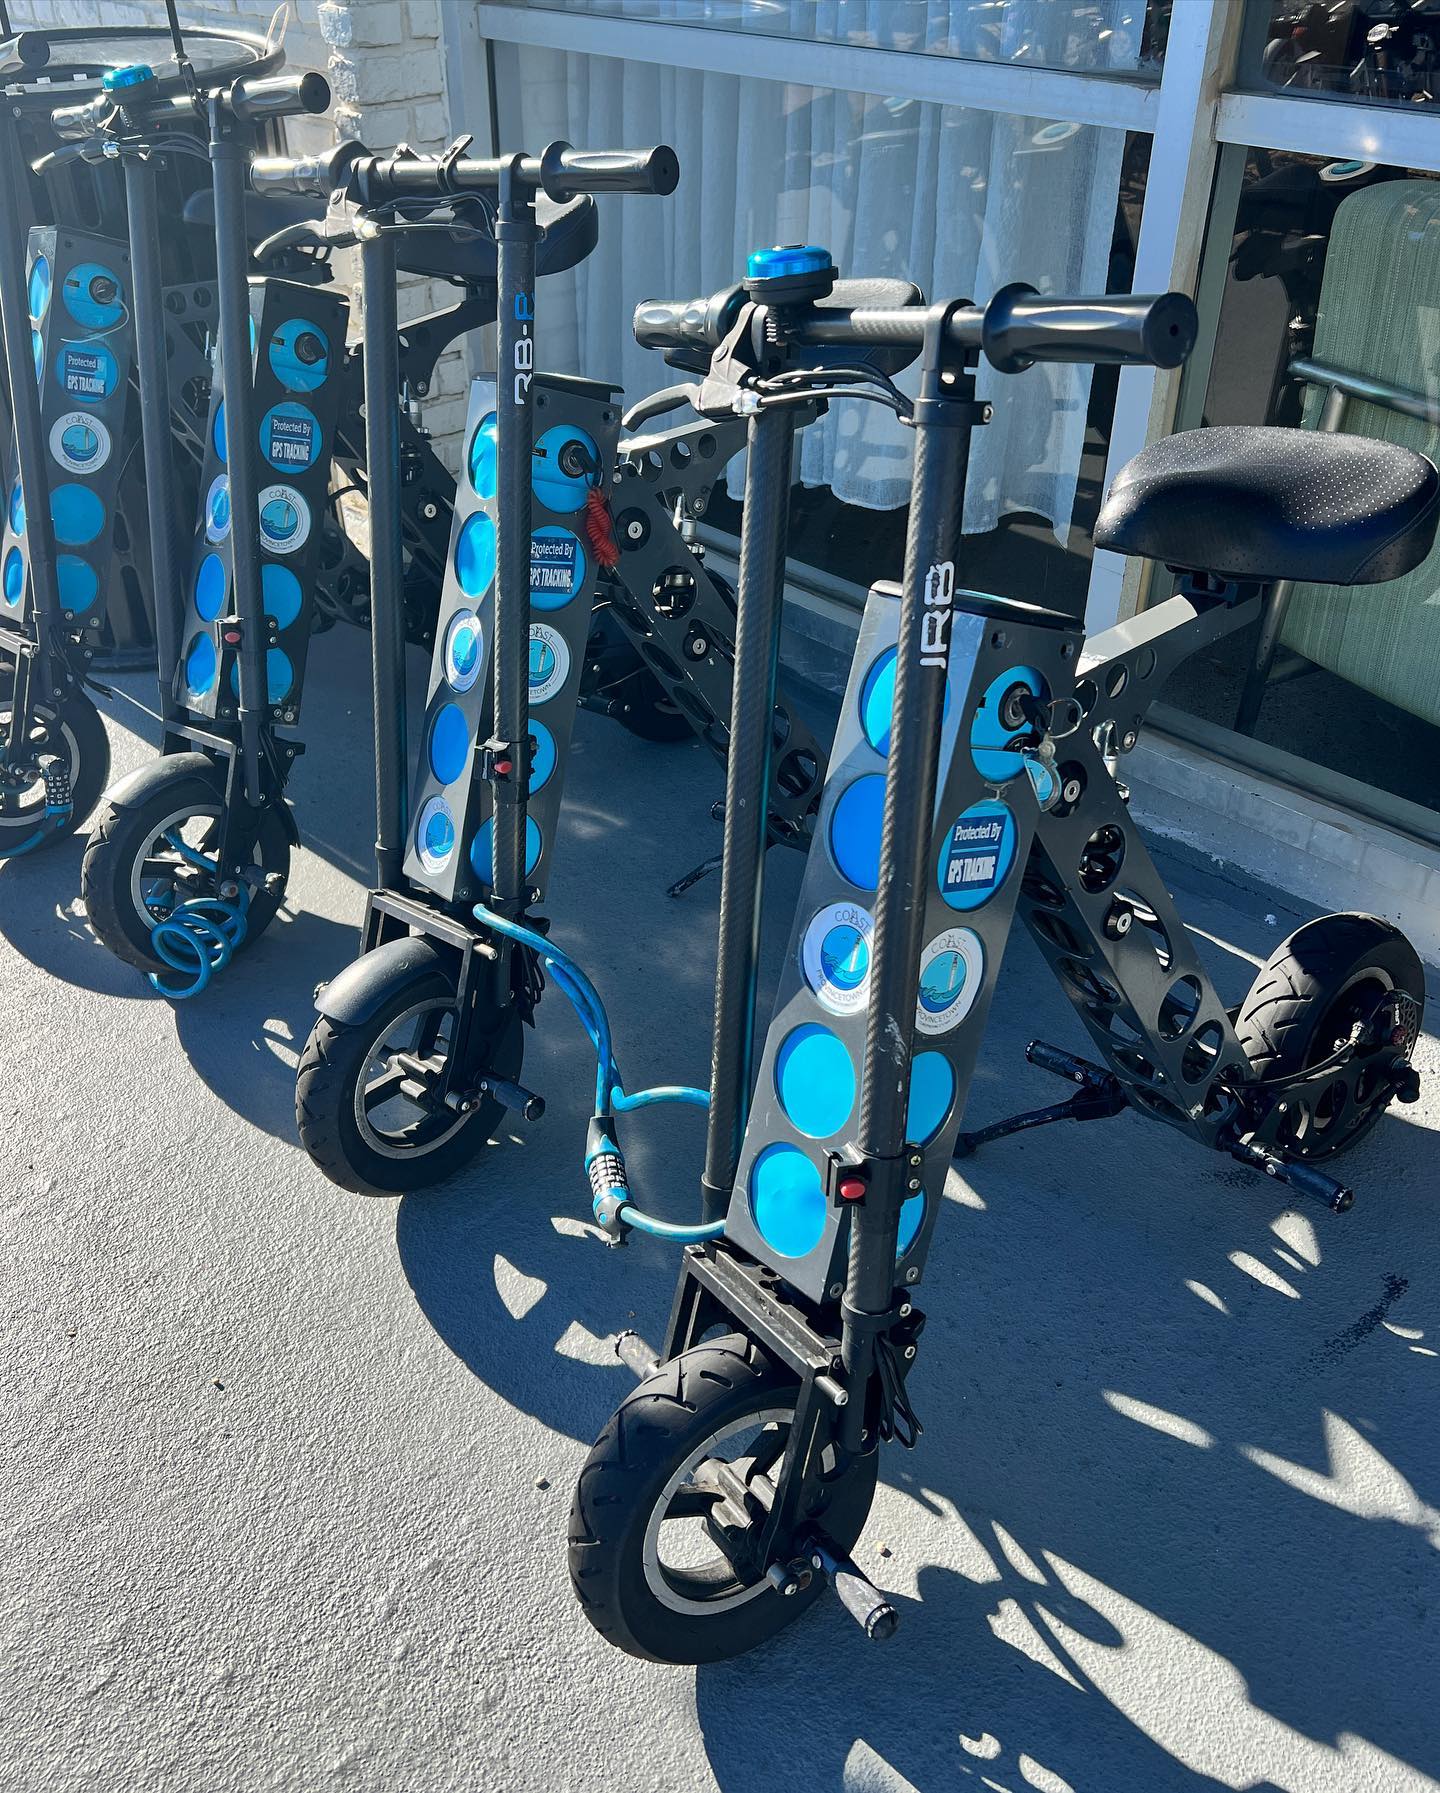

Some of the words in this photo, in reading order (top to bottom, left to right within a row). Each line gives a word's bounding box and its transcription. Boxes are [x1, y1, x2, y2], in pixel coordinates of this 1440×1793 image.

[67, 355, 97, 369] Protected
[67, 375, 79, 390] GPS
[79, 376, 105, 394] TRACKING
[272, 419, 302, 433] Protected
[302, 422, 312, 436] By
[272, 441, 283, 458] GPS
[283, 443, 310, 461] TRACKING
[269, 489, 296, 502] COAST
[531, 541, 564, 555] Protected
[564, 543, 574, 558] By
[541, 568, 572, 588] TRACKING
[530, 625, 553, 640] OAST
[954, 822, 992, 841] Protected
[990, 822, 1002, 841] By
[947, 859, 964, 884] GPS
[962, 856, 997, 882] TRACKING
[834, 908, 872, 931] COAST
[930, 934, 968, 954] COAST
[816, 967, 863, 1001] PROVINCETOWN
